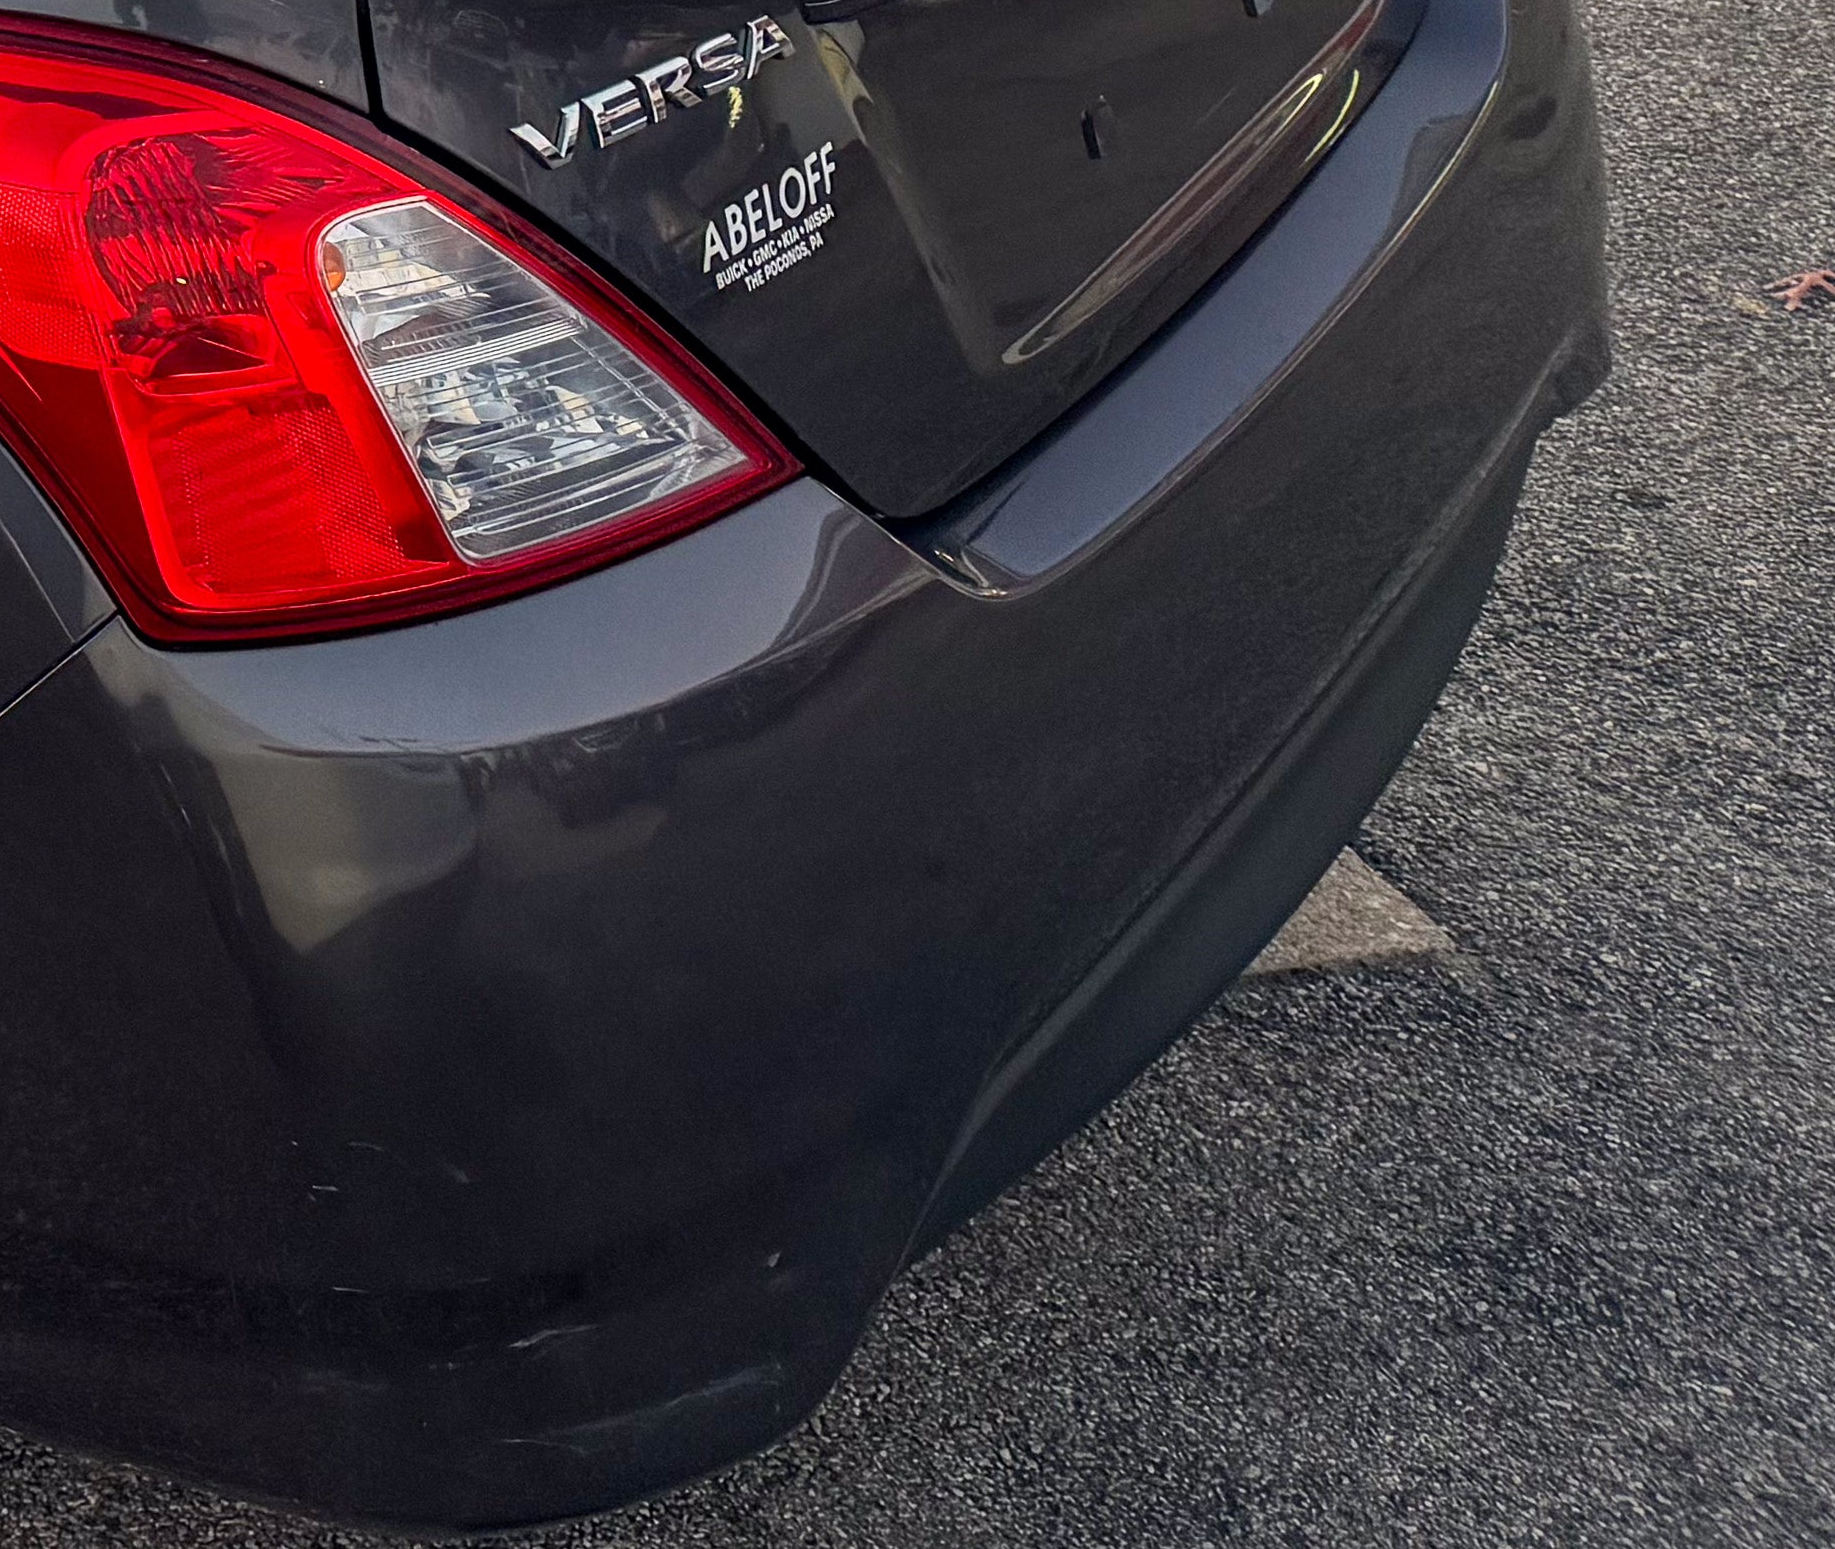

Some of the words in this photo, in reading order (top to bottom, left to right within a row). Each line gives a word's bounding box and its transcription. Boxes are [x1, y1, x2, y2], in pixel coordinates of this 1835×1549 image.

[509, 14, 796, 170] VERSA
[703, 141, 836, 274] ABELOFF
[715, 258, 748, 290] BUICK
[753, 240, 778, 266] GMC
[781, 226, 800, 248] KIA
[744, 271, 765, 292] THE
[809, 232, 824, 251] PA
